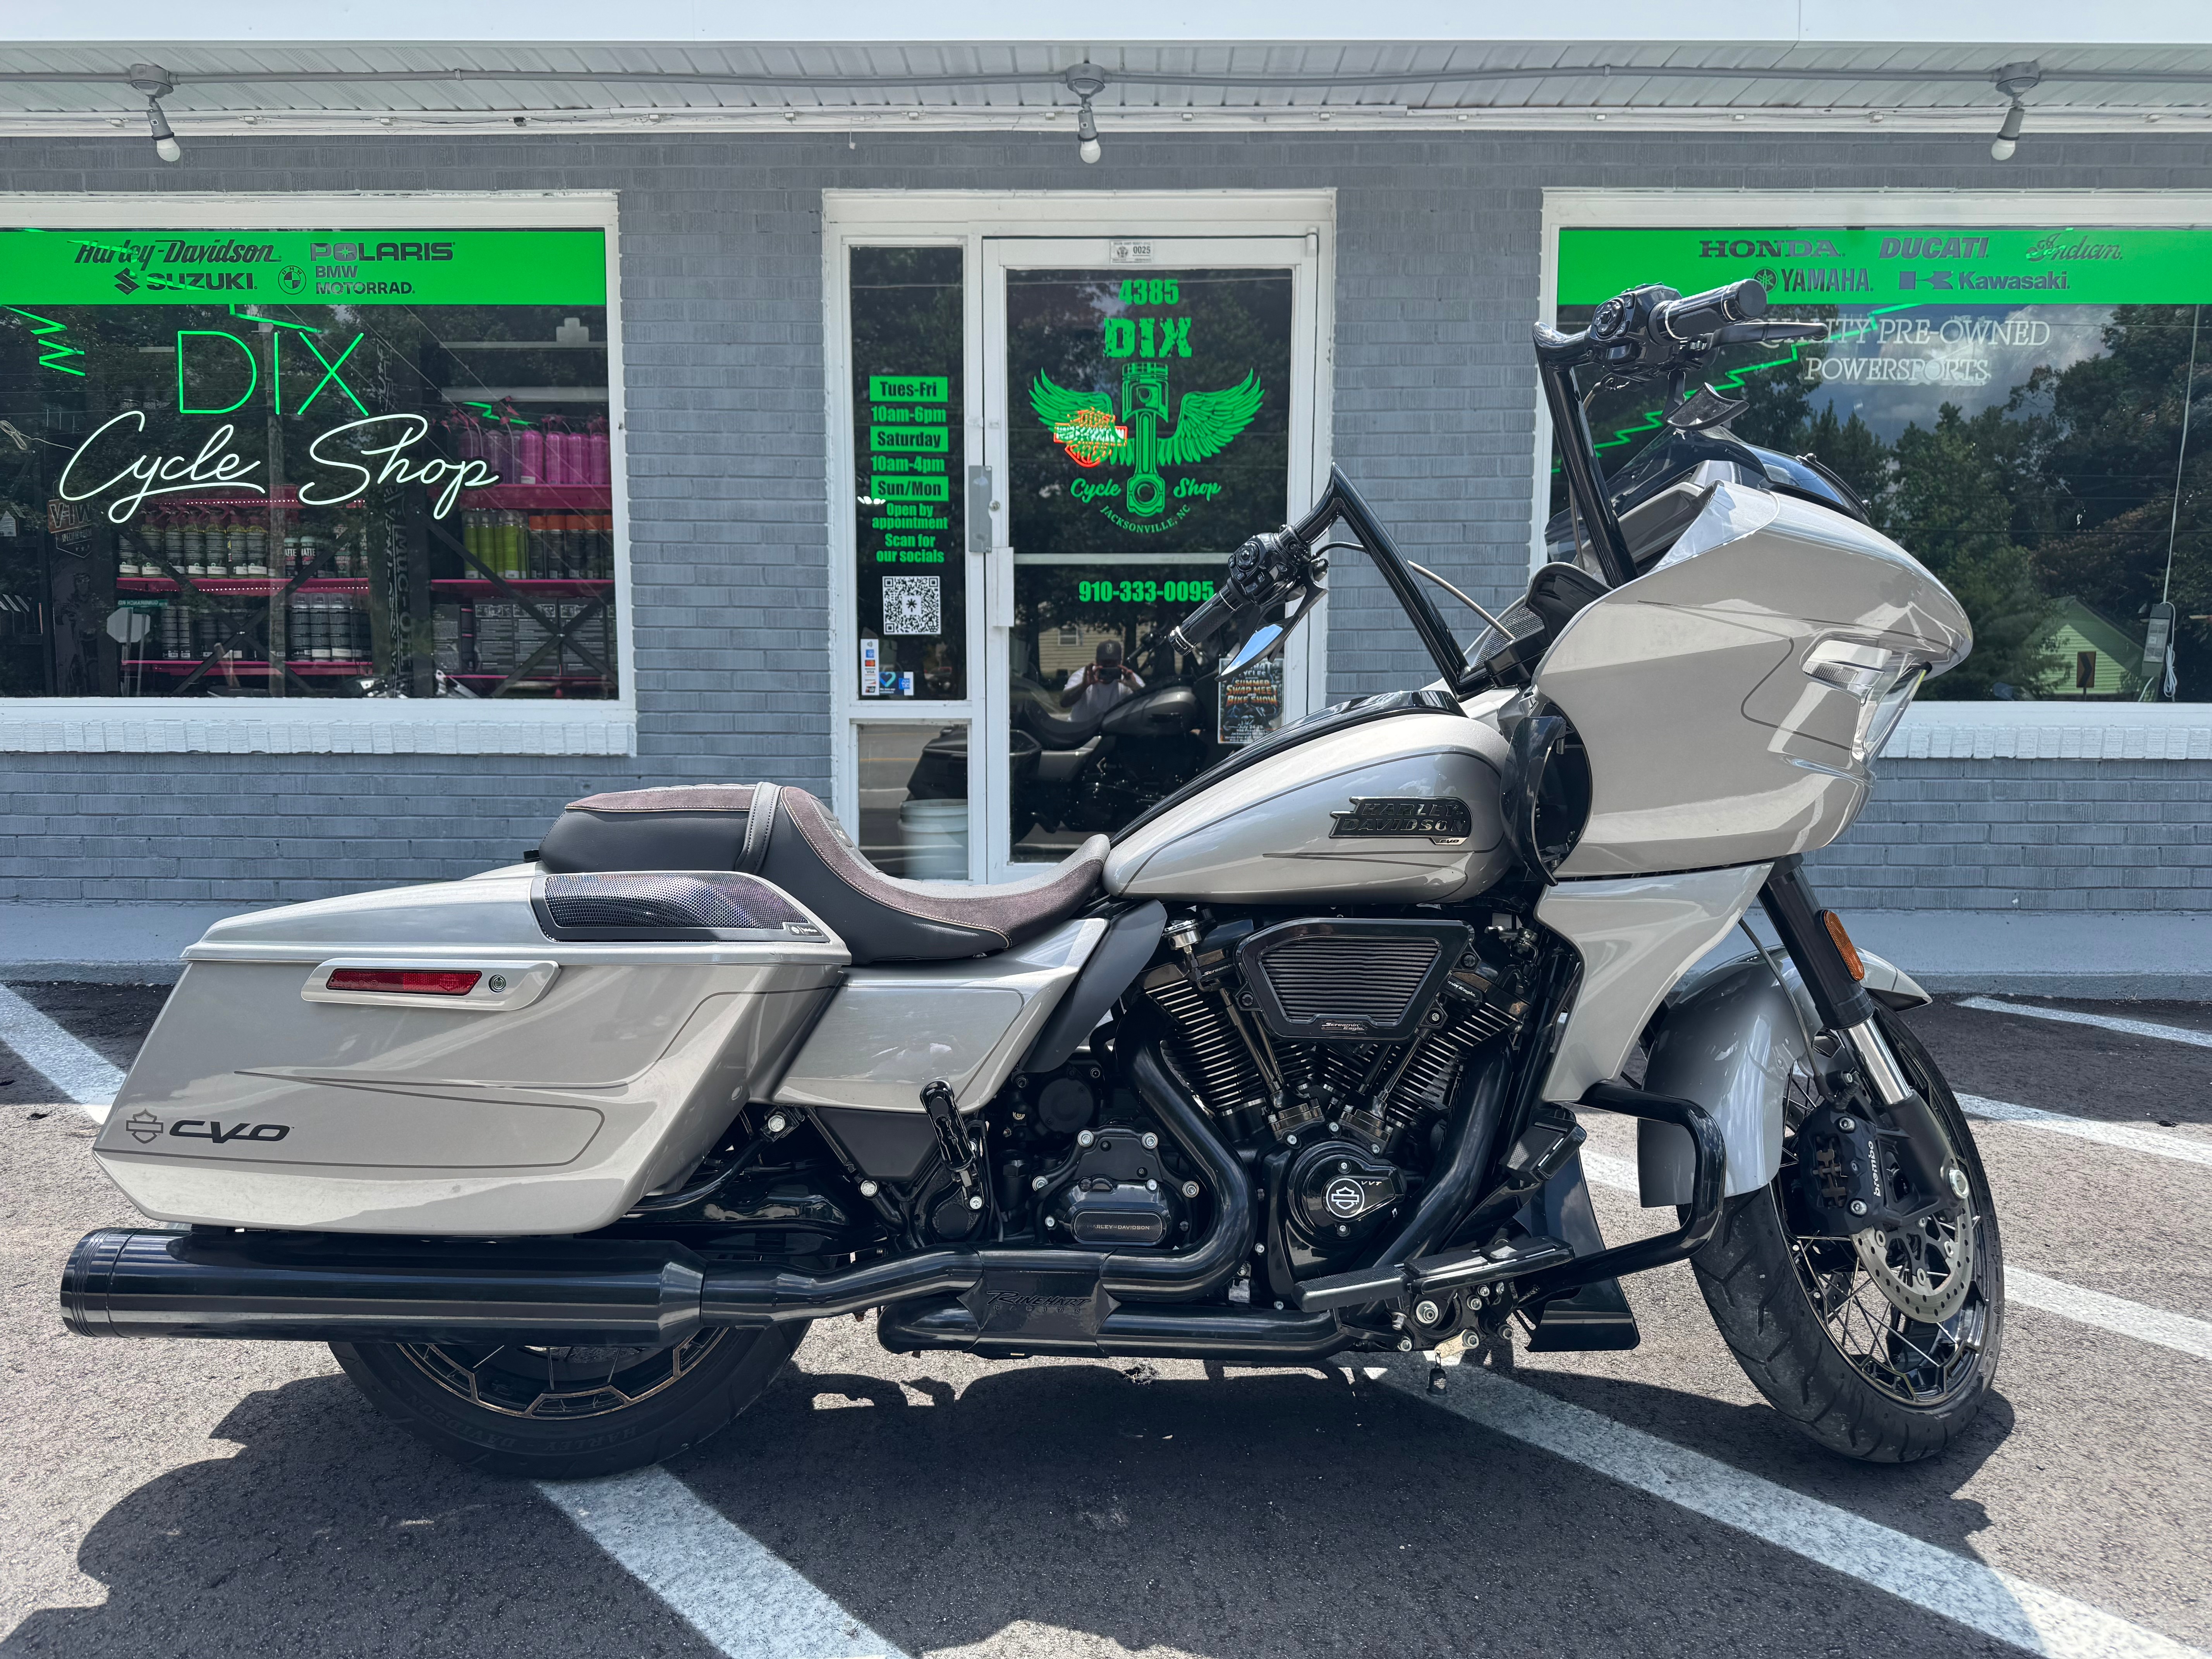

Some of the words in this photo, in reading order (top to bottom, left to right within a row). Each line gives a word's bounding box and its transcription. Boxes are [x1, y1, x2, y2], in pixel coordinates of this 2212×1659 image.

[75, 239, 281, 271] Harley-Davidson
[310, 242, 453, 261] POLARIS
[1699, 240, 1840, 258] HONDA
[1879, 237, 1988, 259] DUCATI
[2026, 233, 2121, 263] Indian
[147, 273, 253, 290] SUZUKI
[316, 266, 358, 278] BMW
[1782, 268, 1868, 292] YAMAHA
[1959, 271, 2067, 290] Kawasaki
[316, 282, 413, 294] MOTORRAD
[1118, 279, 1179, 305] 4385
[1103, 317, 1192, 358] DIX
[1877, 318, 2050, 346] PRE-OWNED
[177, 330, 369, 416] DIX
[1803, 357, 1991, 381] POWERSPORTS
[879, 381, 937, 397] Tues-Fri
[871, 406, 946, 423] 10am-6pm
[877, 431, 941, 448] Saturday
[59, 410, 266, 523] Cycle
[298, 413, 499, 520] Shop
[871, 456, 945, 472] 10am-4pm
[878, 481, 941, 496] Sun/Mon
[1070, 477, 1122, 503] Cycle
[1173, 477, 1221, 501] Shop
[886, 503, 916, 517] Open
[919, 503, 933, 517] by
[1100, 505, 1178, 533] JACKSONVILLE,
[1177, 504, 1191, 520] NC
[872, 517, 948, 530] appointment
[885, 534, 915, 547] Scan
[918, 534, 935, 547] for
[876, 551, 897, 563] our
[900, 550, 945, 563] socials
[1079, 580, 1214, 602] 910-333-0095
[1226, 684, 1252, 696] SWAP
[1254, 684, 1278, 696] MEET
[1226, 695, 1249, 707] BIKE
[1250, 695, 1278, 707] SHOW
[1341, 818, 1466, 831] DAVIDSON
[169, 1120, 290, 1144] CVO
[1868, 1140, 1881, 1197] brembo
